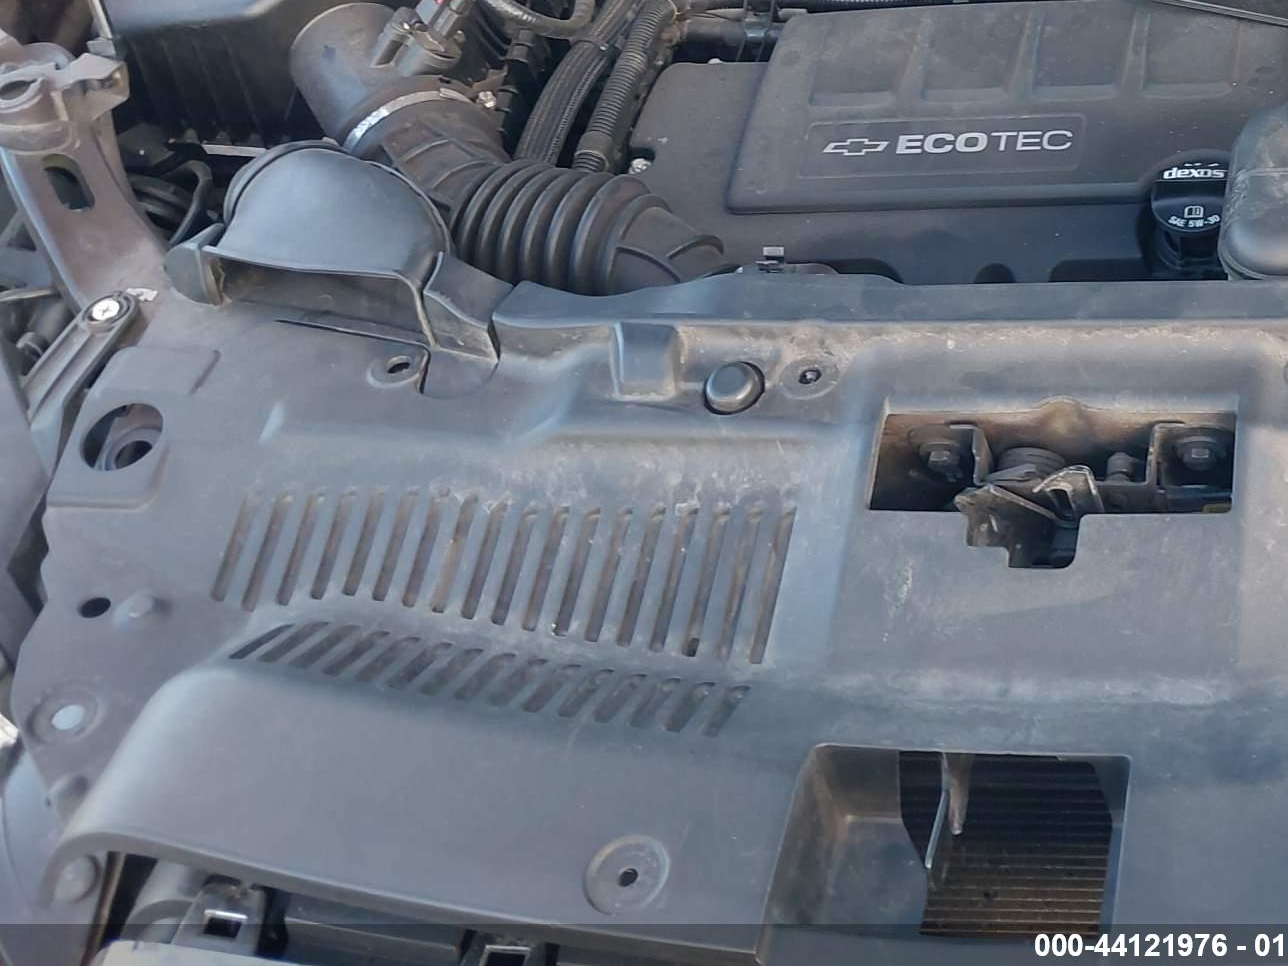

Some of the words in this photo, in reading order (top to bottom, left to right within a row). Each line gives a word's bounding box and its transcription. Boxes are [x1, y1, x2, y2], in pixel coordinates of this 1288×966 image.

[896, 131, 1073, 155] ECOTEC
[1163, 167, 1228, 180] dexos
[1168, 215, 1188, 228] SAE
